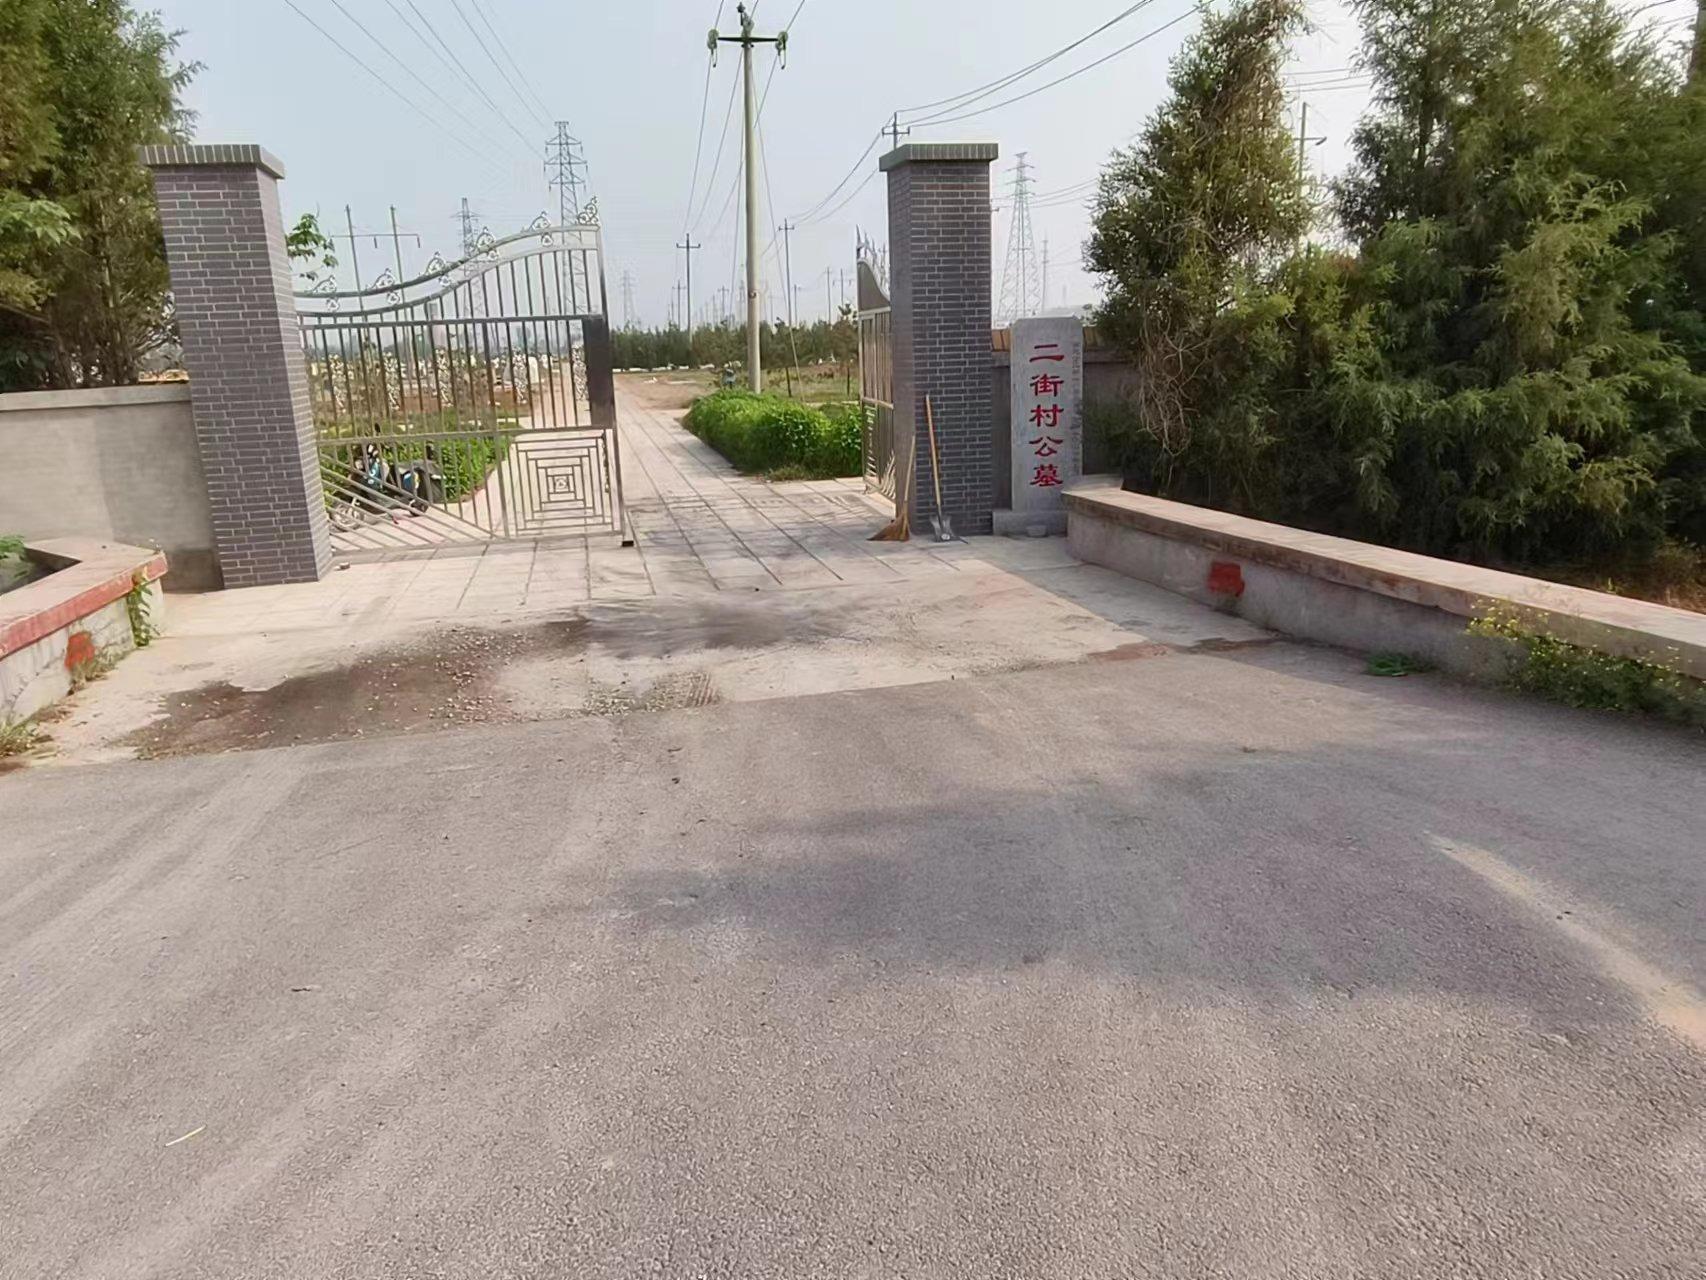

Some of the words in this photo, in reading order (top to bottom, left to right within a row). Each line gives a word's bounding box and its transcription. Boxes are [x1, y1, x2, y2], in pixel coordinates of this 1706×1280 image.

[1029, 343, 1065, 487] 二街村公墓
